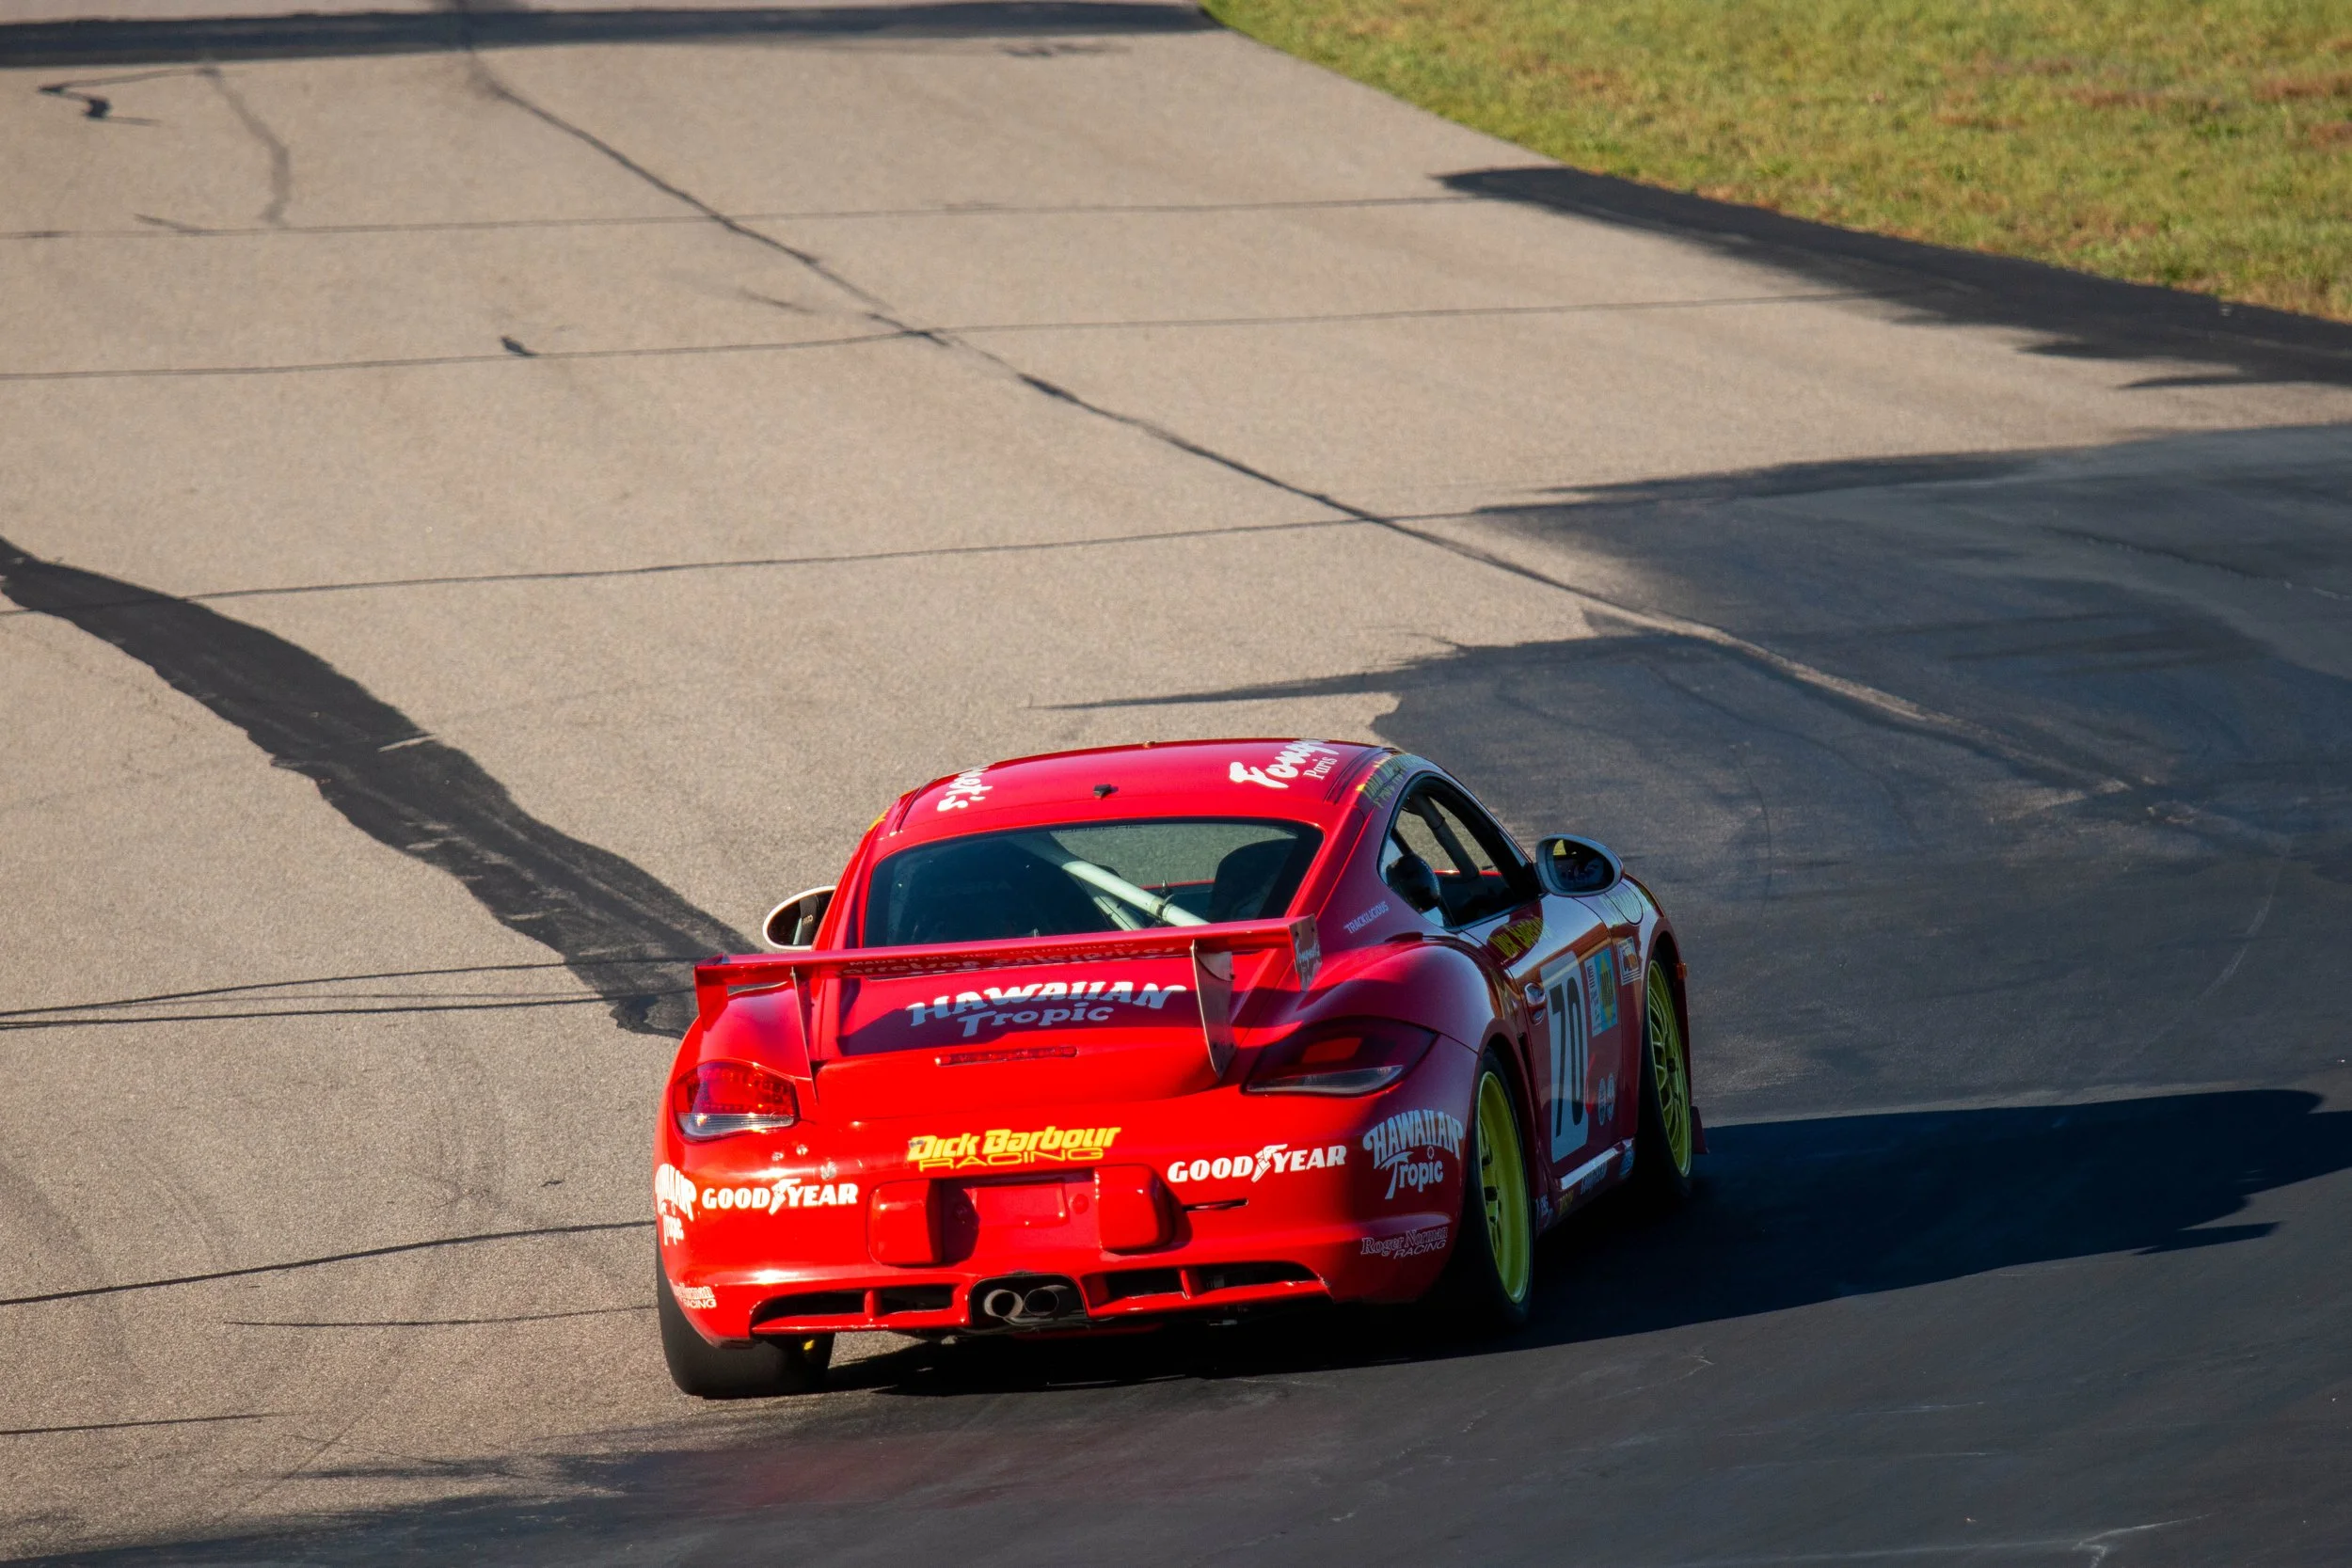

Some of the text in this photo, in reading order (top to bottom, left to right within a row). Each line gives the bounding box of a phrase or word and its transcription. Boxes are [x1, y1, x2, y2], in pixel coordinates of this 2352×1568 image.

[1302, 756, 1337, 781] Paris
[906, 981, 1186, 1026] HAWAIIAN
[958, 1002, 1114, 1037] Tropic
[1549, 976, 1586, 1138] 70
[907, 1126, 1121, 1162] Dick Barbour
[1362, 1109, 1464, 1169] HAWAIIAN
[919, 1147, 1104, 1172] RACING
[1380, 1146, 1444, 1200] Tropic
[1360, 1226, 1449, 1257] Roger Norman
[1393, 1239, 1447, 1259] RACING
